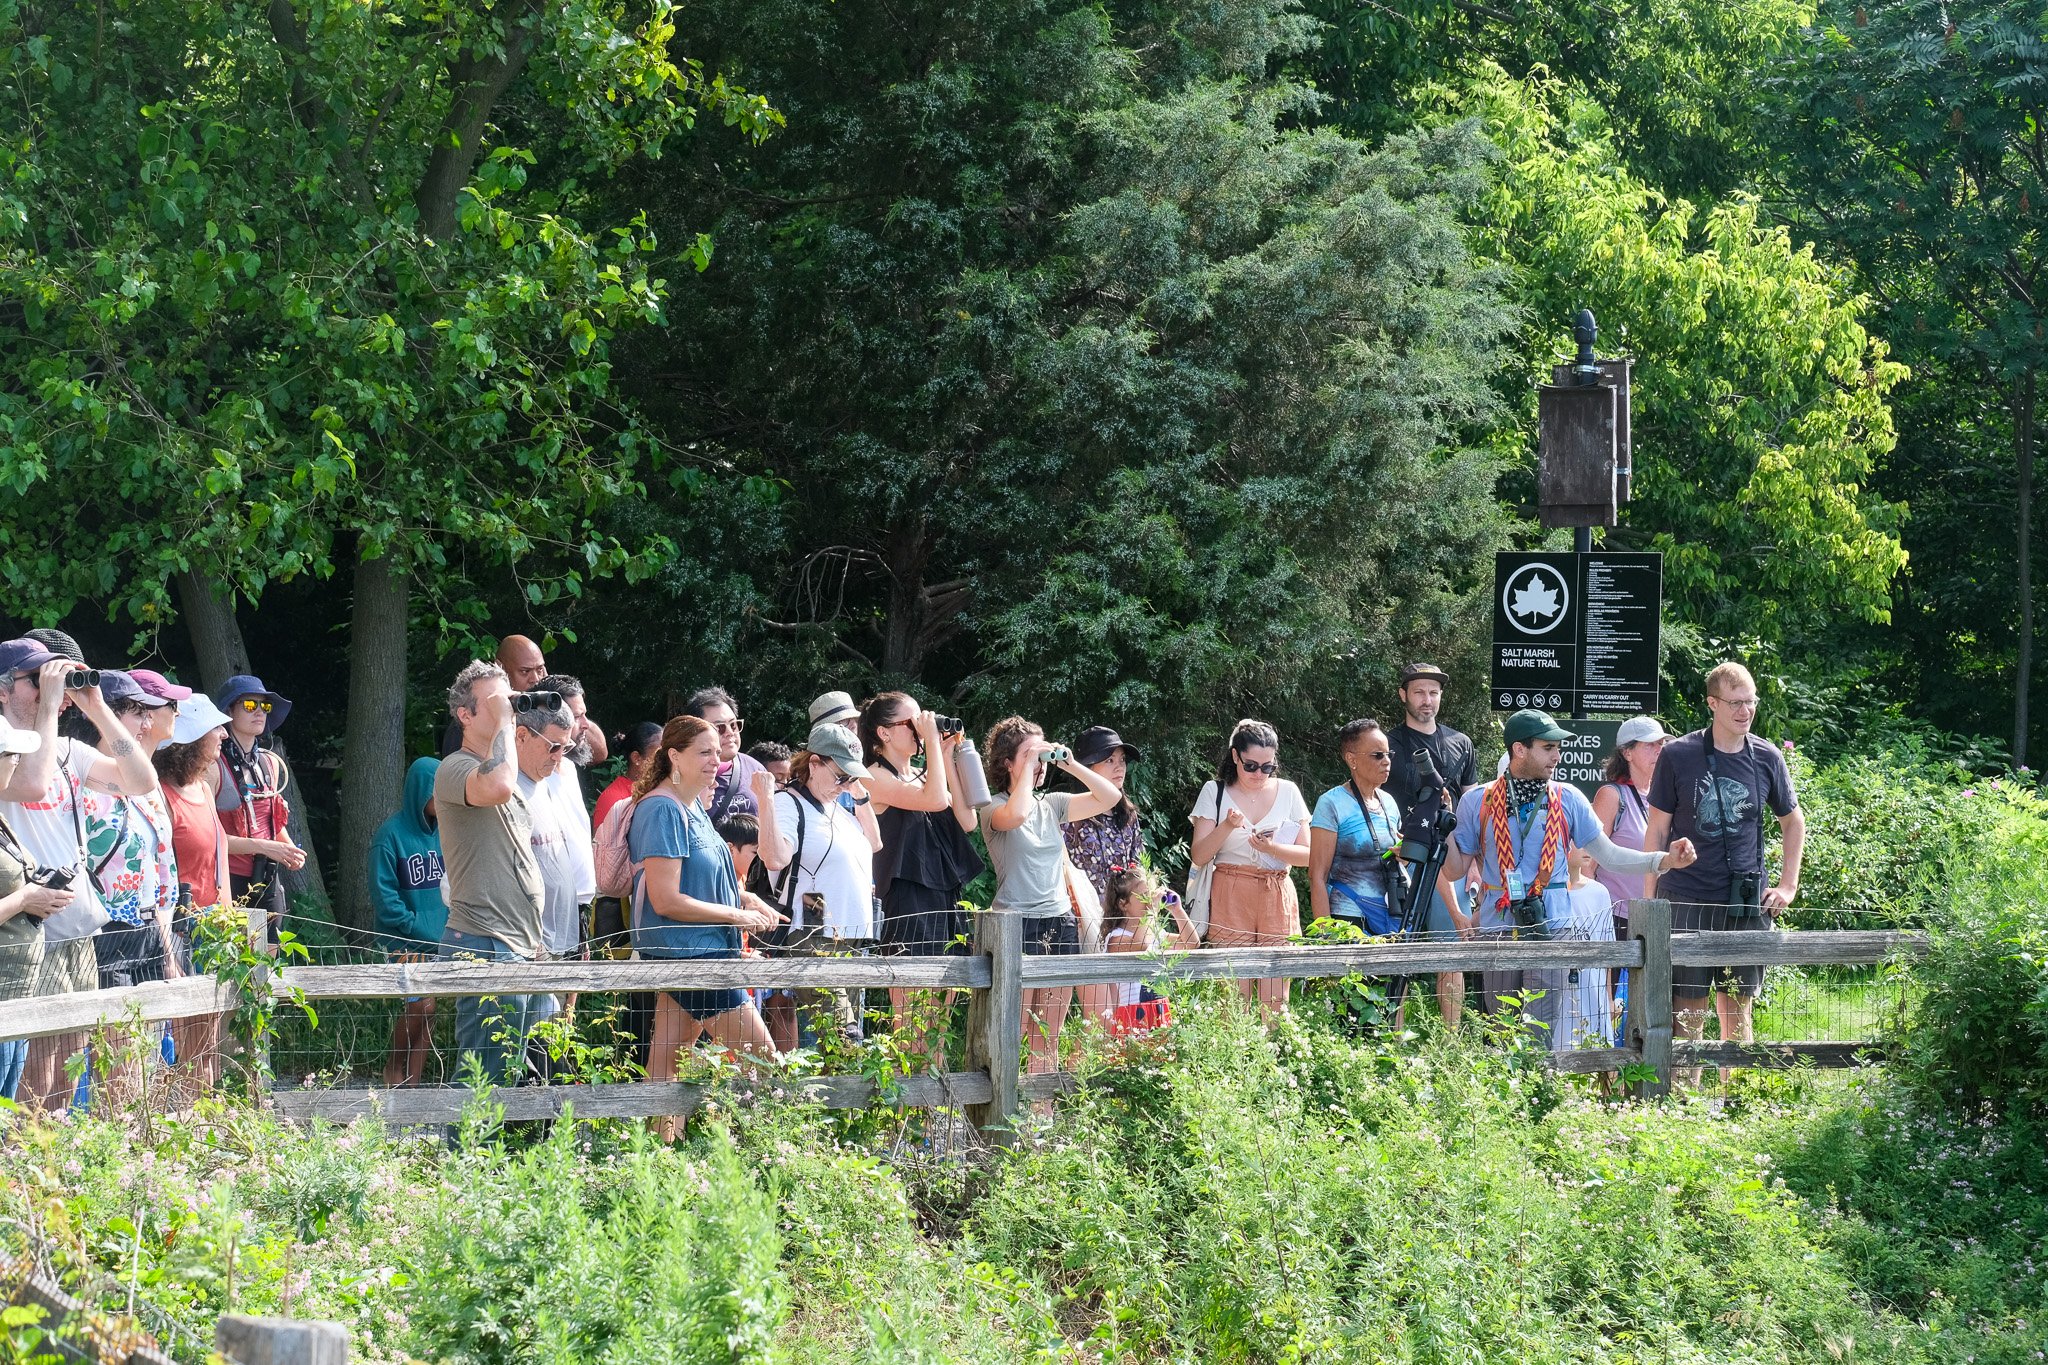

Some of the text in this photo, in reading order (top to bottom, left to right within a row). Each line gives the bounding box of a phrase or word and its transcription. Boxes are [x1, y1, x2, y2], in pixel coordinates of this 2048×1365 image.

[1502, 648, 1554, 658] SALT MARSH
[1502, 658, 1560, 668] NATURE TRAIL
[1561, 735, 1601, 748] BIKES
[1558, 752, 1593, 764] YOND
[1552, 768, 1604, 781] IS POIN
[407, 850, 444, 886] GA
